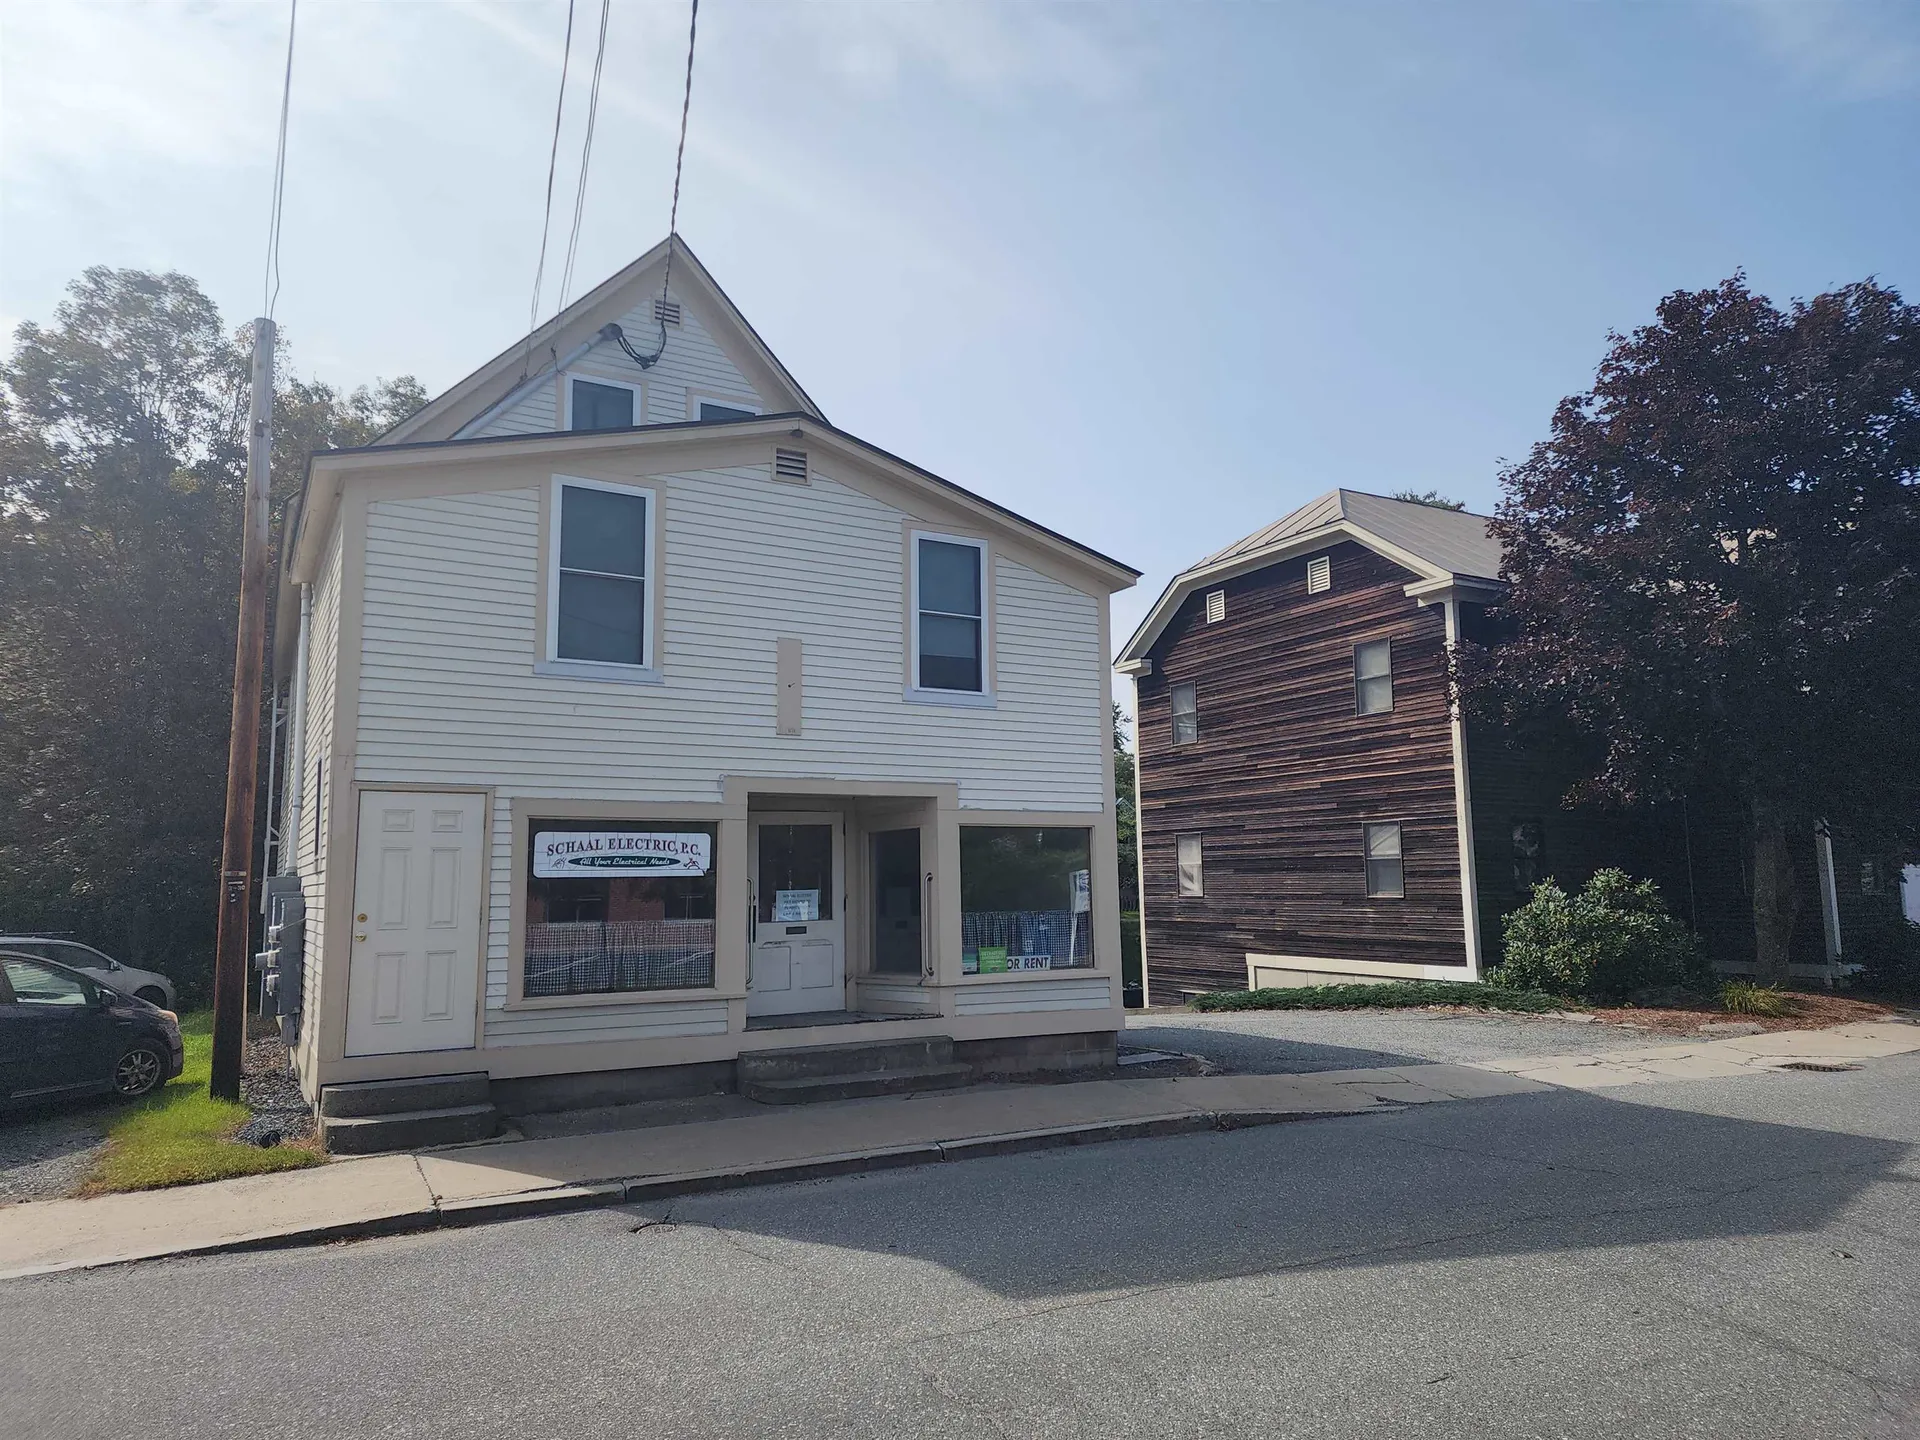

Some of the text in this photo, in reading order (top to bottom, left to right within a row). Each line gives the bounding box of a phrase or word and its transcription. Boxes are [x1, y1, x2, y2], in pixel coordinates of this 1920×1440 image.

[547, 839, 603, 856] SCHAAL
[608, 838, 679, 854] ELECTRIC,
[580, 856, 671, 867] All Your Electrical Needs
[1007, 957, 1049, 969] OR RENT
